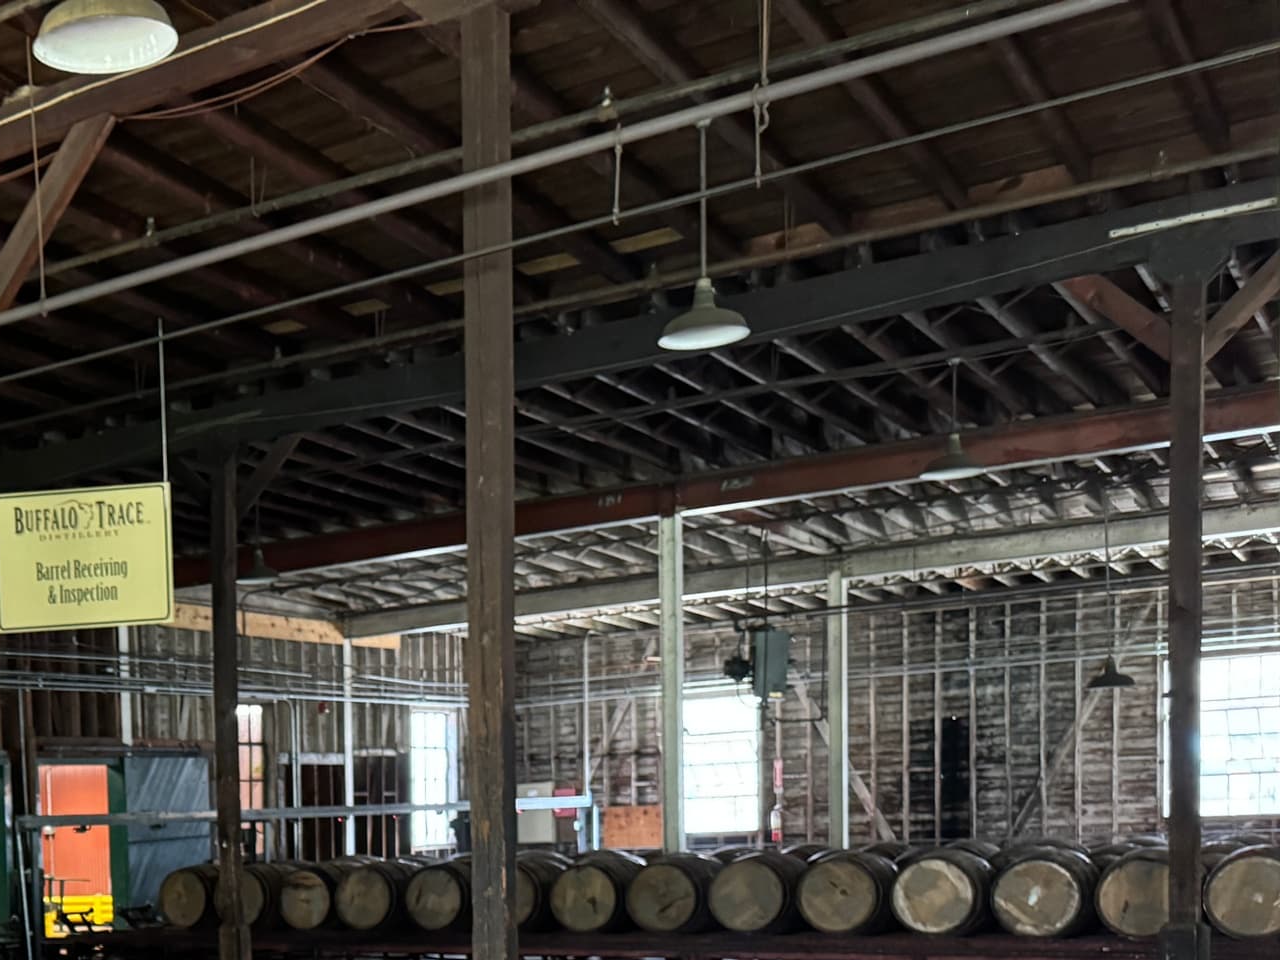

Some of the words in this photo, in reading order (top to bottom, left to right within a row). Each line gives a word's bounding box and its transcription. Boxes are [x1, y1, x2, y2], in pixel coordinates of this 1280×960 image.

[13, 506, 79, 535] BUFFALO
[95, 500, 145, 529] TRACE
[39, 529, 121, 542] DISTILLERY
[35, 560, 70, 581] Barrel
[73, 557, 128, 579] Receiving
[47, 585, 57, 605] &
[59, 582, 119, 606] Inspection
